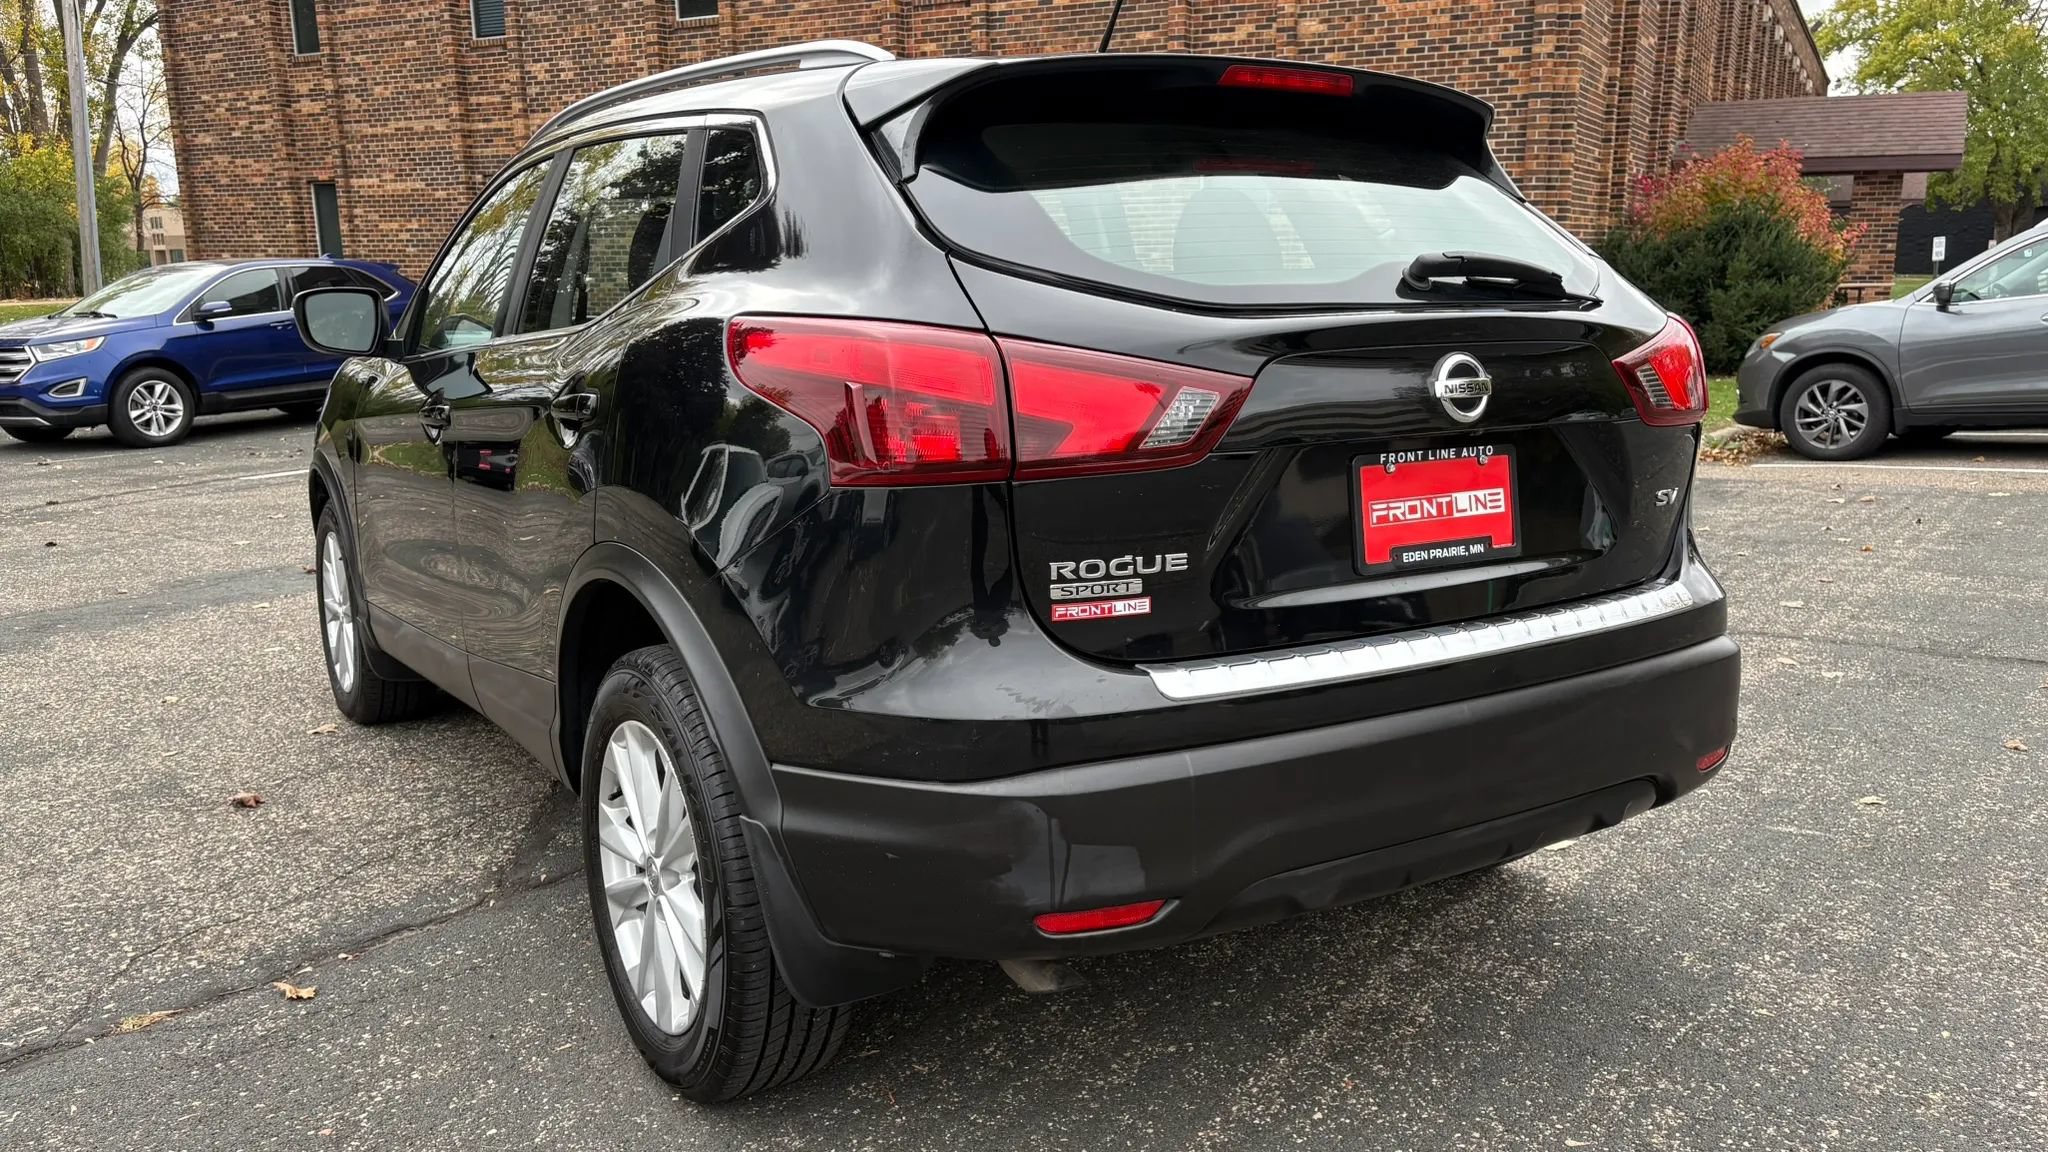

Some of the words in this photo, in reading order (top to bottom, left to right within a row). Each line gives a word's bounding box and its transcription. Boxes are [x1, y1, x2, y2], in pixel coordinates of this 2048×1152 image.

[1444, 382, 1489, 394] NISSAN
[1380, 450, 1424, 464] FRONT
[1428, 448, 1457, 460] LINE
[1461, 445, 1494, 458] AUTO
[1371, 491, 1503, 524] FRONTLINE
[1402, 549, 1428, 563] EDEN
[1430, 545, 1469, 560] PRAIRIE,
[1469, 543, 1485, 555] MN
[1049, 552, 1189, 581] ROGUE
[1060, 581, 1136, 597] SPORT
[1054, 599, 1150, 618] FRONTLINE
